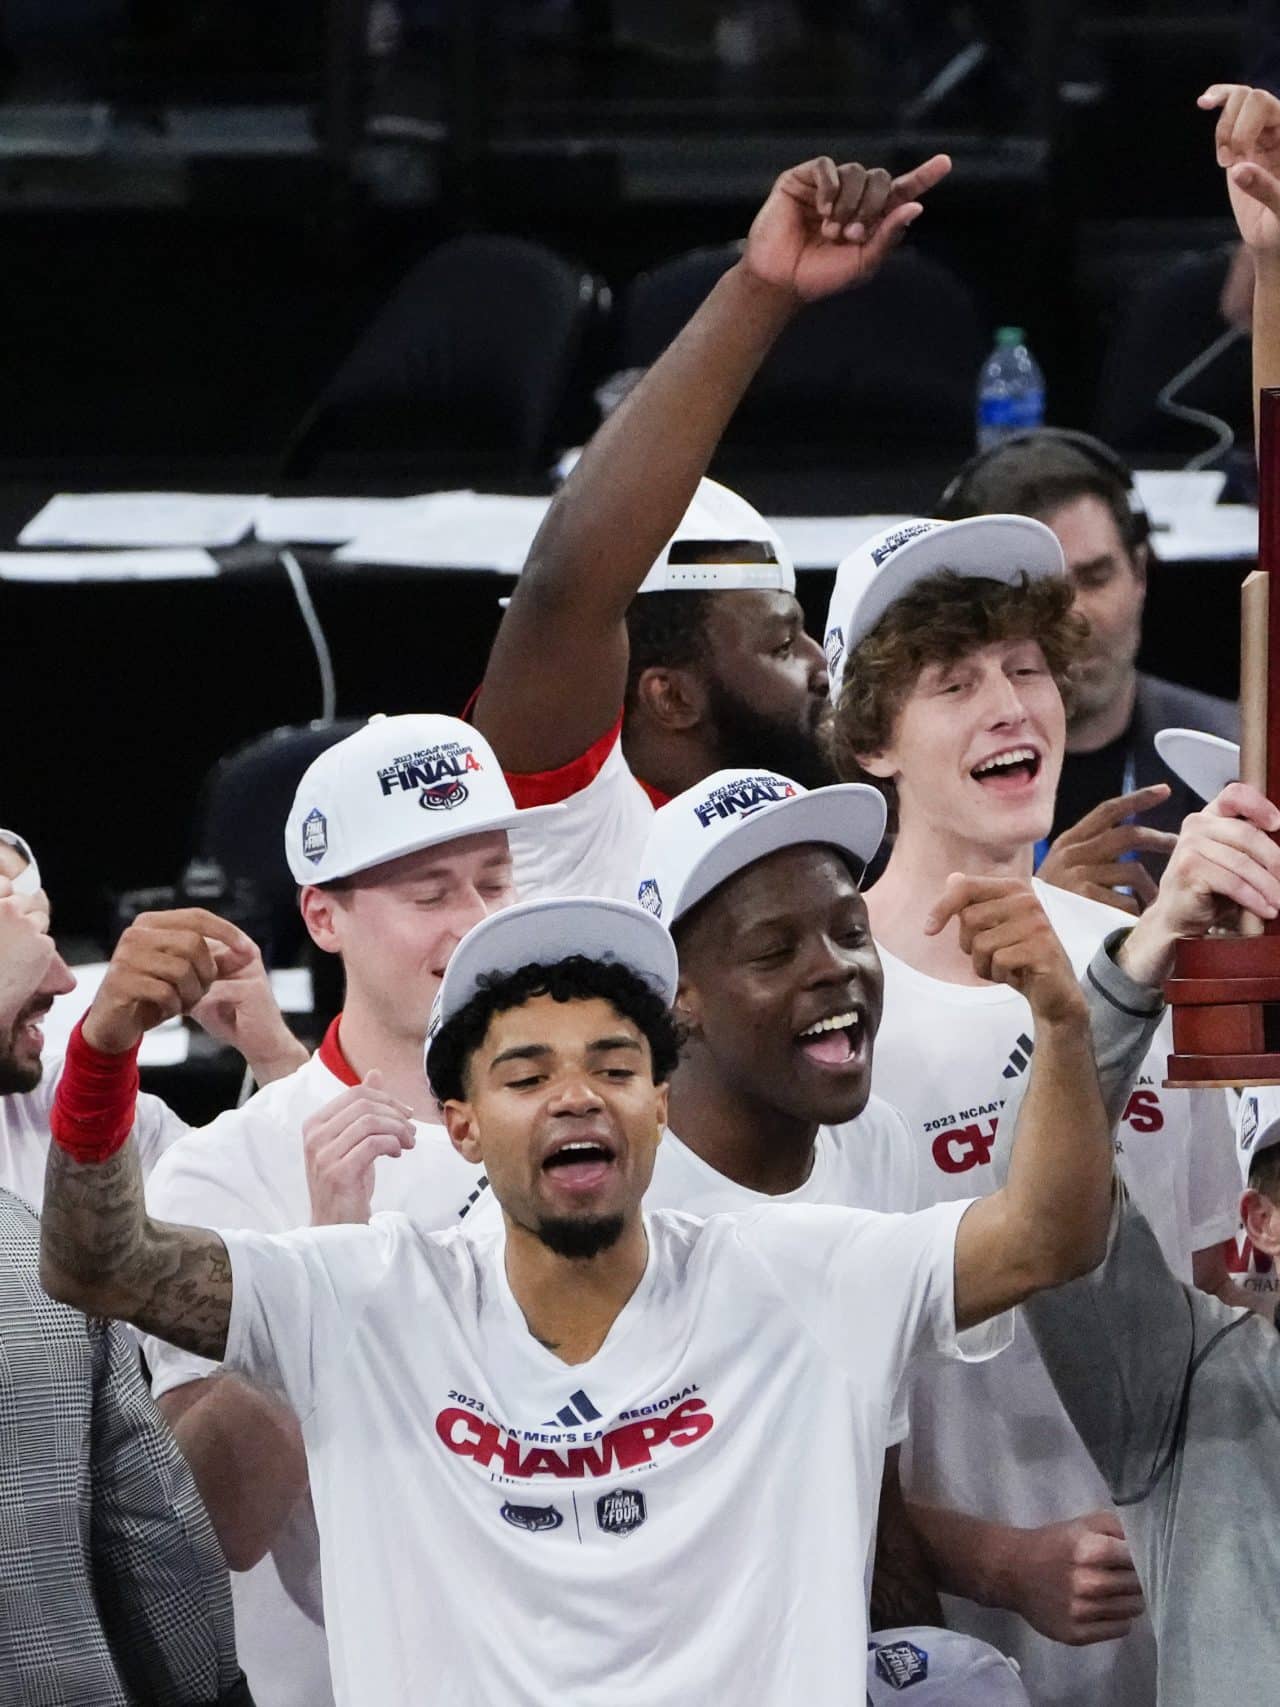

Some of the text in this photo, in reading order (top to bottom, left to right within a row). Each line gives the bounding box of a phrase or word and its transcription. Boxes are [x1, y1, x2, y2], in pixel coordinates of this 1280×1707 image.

[376, 764, 402, 778] EAST
[402, 753, 446, 771] REGIONAL
[379, 753, 480, 797] FINAL 4
[698, 783, 787, 828] FINAL
[923, 1113, 957, 1132] 2023
[447, 1384, 700, 1444] 2023 MEN'S EA REGIONAL
[435, 1397, 715, 1479] CHAMPS
[604, 1494, 637, 1514] FINAL
[608, 1505, 640, 1527] FOUR
